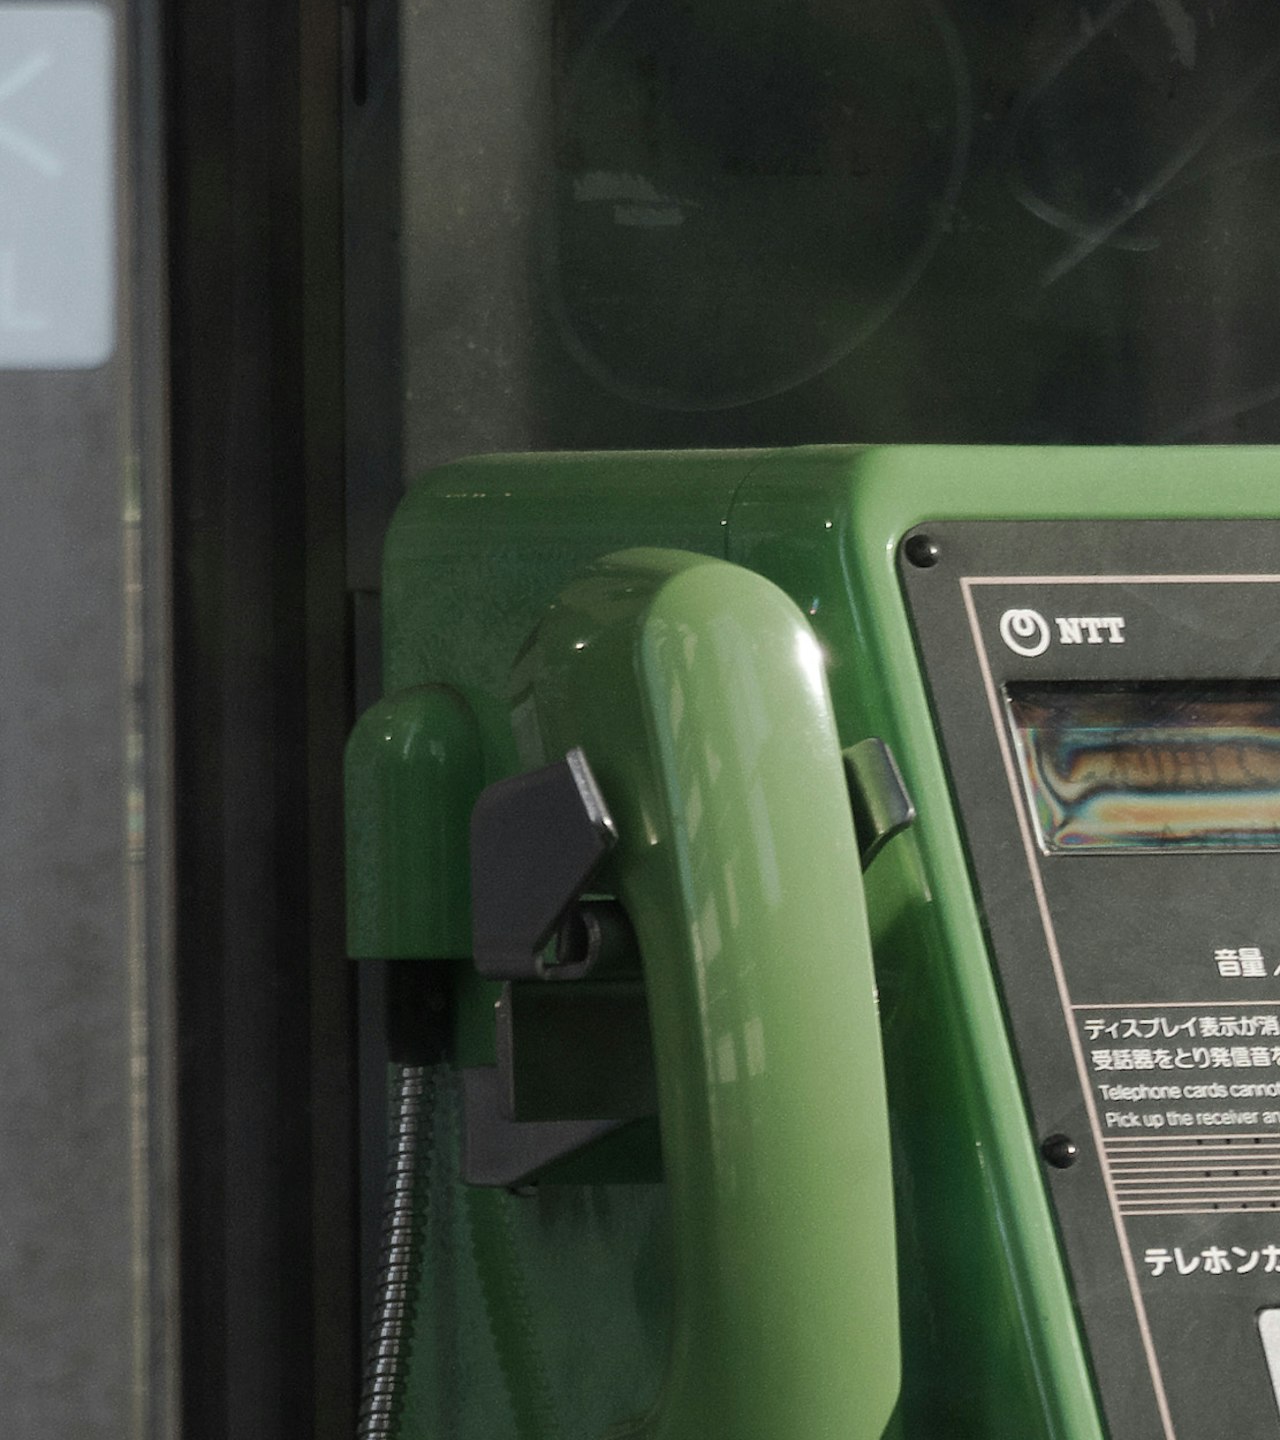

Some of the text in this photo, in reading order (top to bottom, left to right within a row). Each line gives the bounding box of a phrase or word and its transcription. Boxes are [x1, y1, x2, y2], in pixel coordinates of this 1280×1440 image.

[1055, 616, 1126, 645] NTT
[1098, 1083, 1182, 1102] Telephone
[1183, 1082, 1229, 1099] cards
[1105, 1111, 1142, 1129] Pick
[1143, 1114, 1165, 1130] up
[1166, 1110, 1195, 1127] the
[1196, 1109, 1260, 1126] receiver
